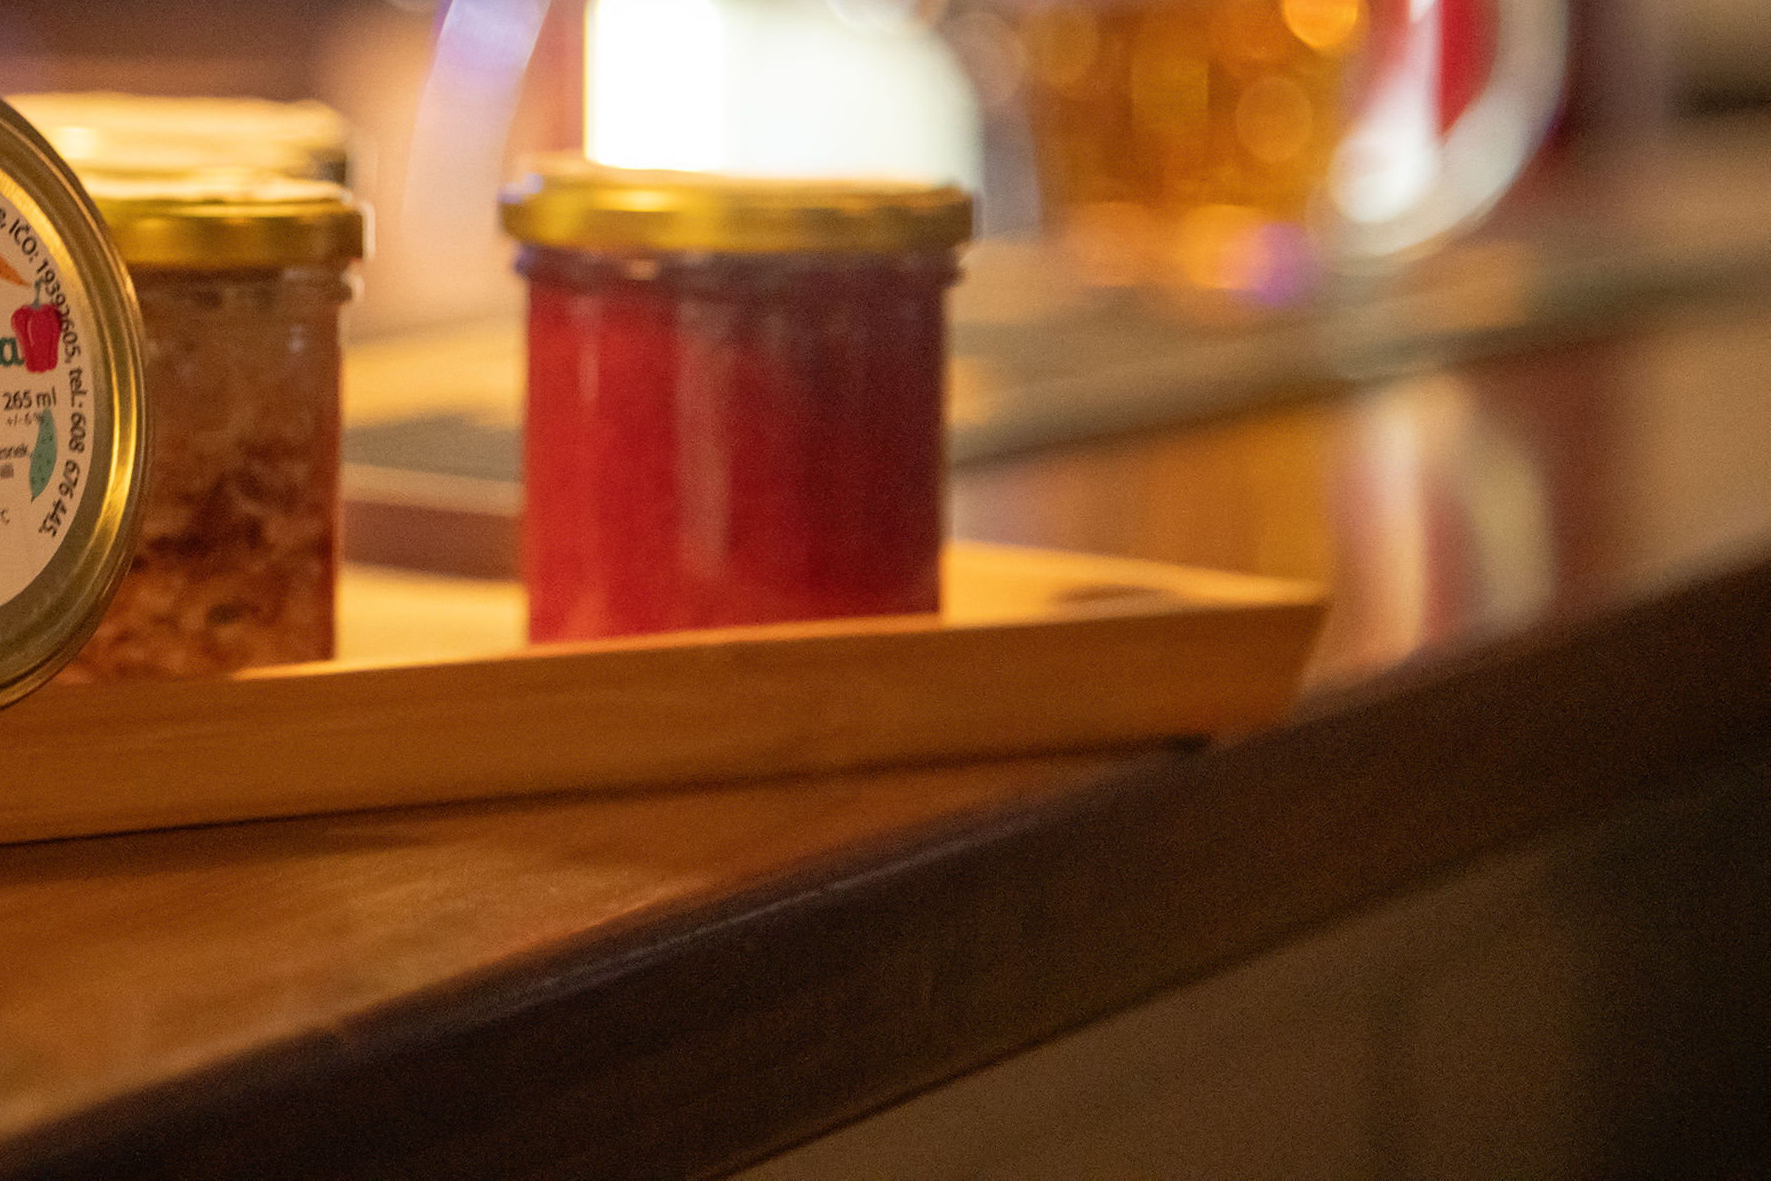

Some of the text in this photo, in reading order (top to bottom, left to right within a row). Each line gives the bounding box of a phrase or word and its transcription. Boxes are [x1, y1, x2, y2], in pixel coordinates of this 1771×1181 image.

[8, 218, 39, 263] IČO:
[2, 386, 57, 411] 265 ml
[68, 412, 87, 454] 608
[58, 459, 81, 500] 676
